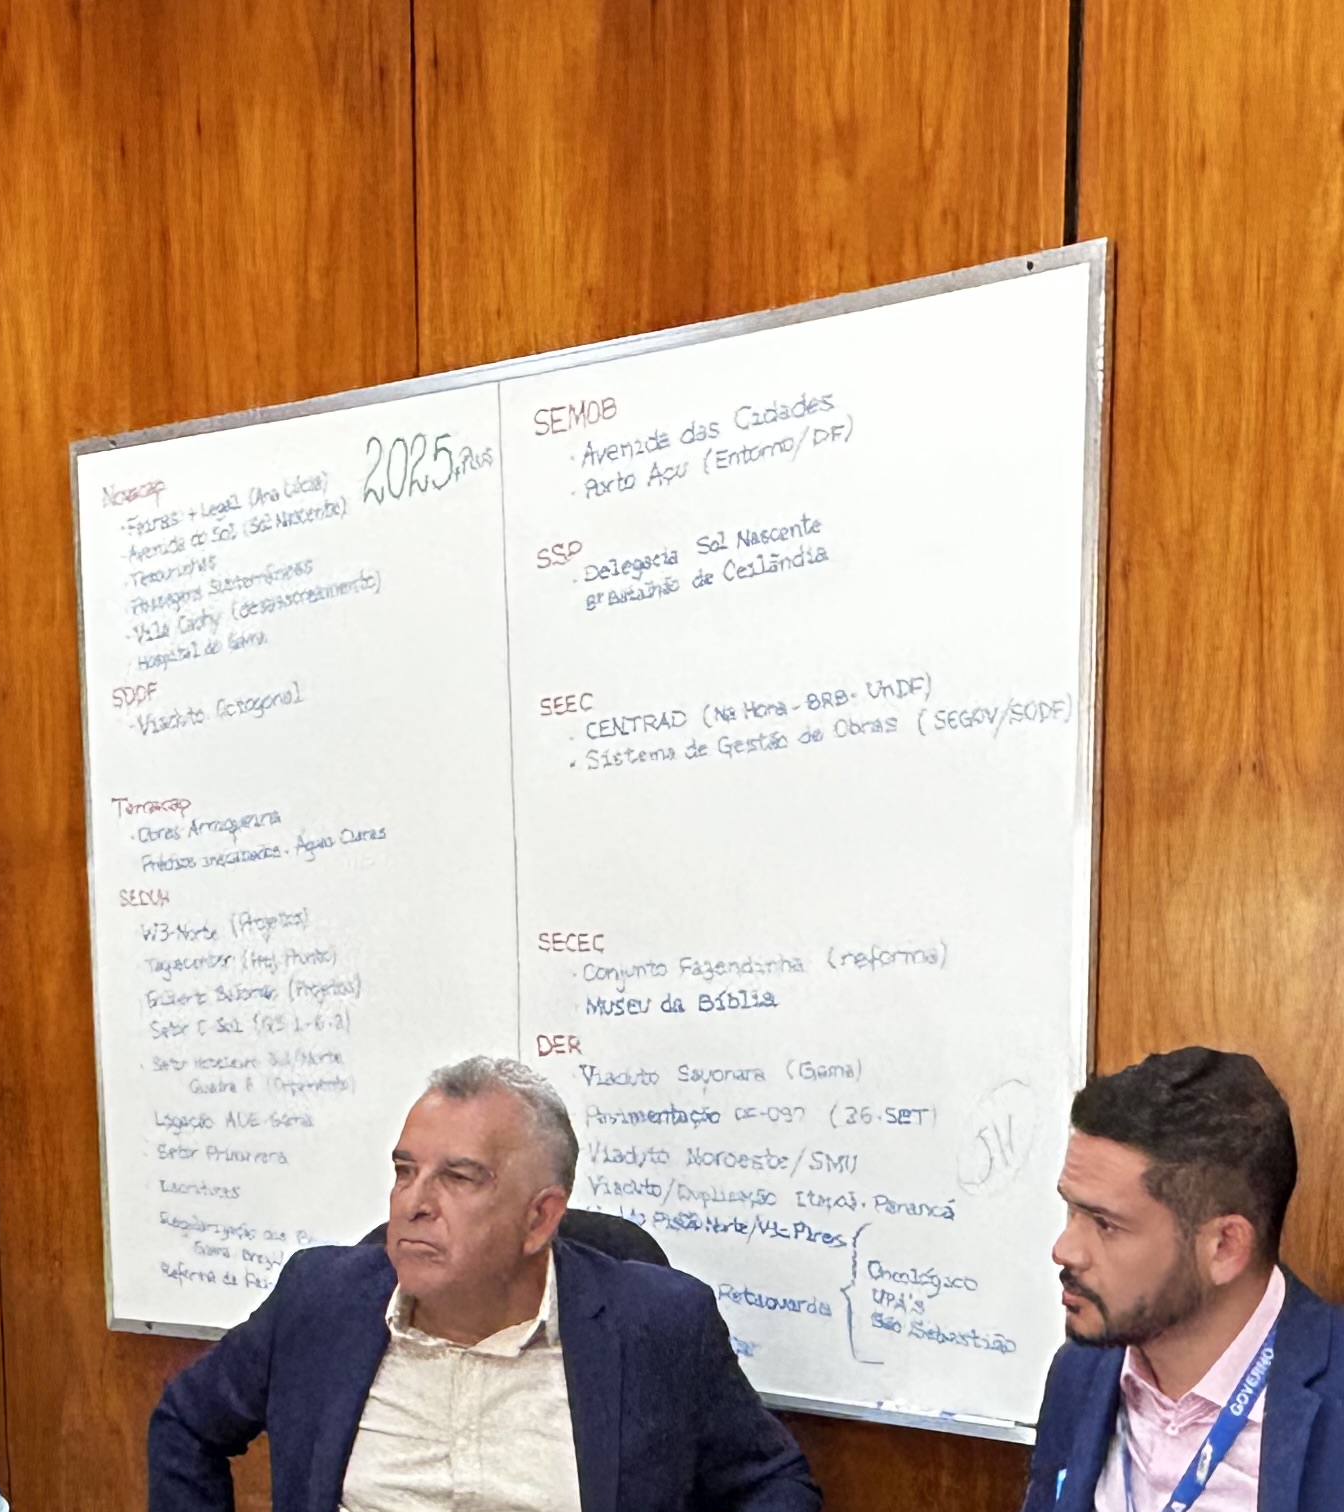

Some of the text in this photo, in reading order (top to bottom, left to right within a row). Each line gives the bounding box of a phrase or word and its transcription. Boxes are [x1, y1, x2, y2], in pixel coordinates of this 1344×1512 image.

[534, 397, 617, 436] SEMOB
[582, 392, 835, 468] Avenida das Cidades
[363, 433, 453, 506] 2025
[696, 532, 728, 555] Sol
[736, 513, 822, 549] Nascente
[692, 568, 713, 589] de
[723, 545, 829, 582] Ceilândia
[539, 693, 593, 716] SEEC
[586, 710, 687, 740] CENTRAD
[586, 747, 676, 771] Sistema
[685, 737, 708, 759] de
[797, 728, 824, 744] de
[834, 716, 898, 738] Obras
[537, 933, 605, 954] SECEC
[582, 963, 668, 993] Conjunto
[660, 992, 685, 1013] da
[537, 1034, 582, 1057] DER
